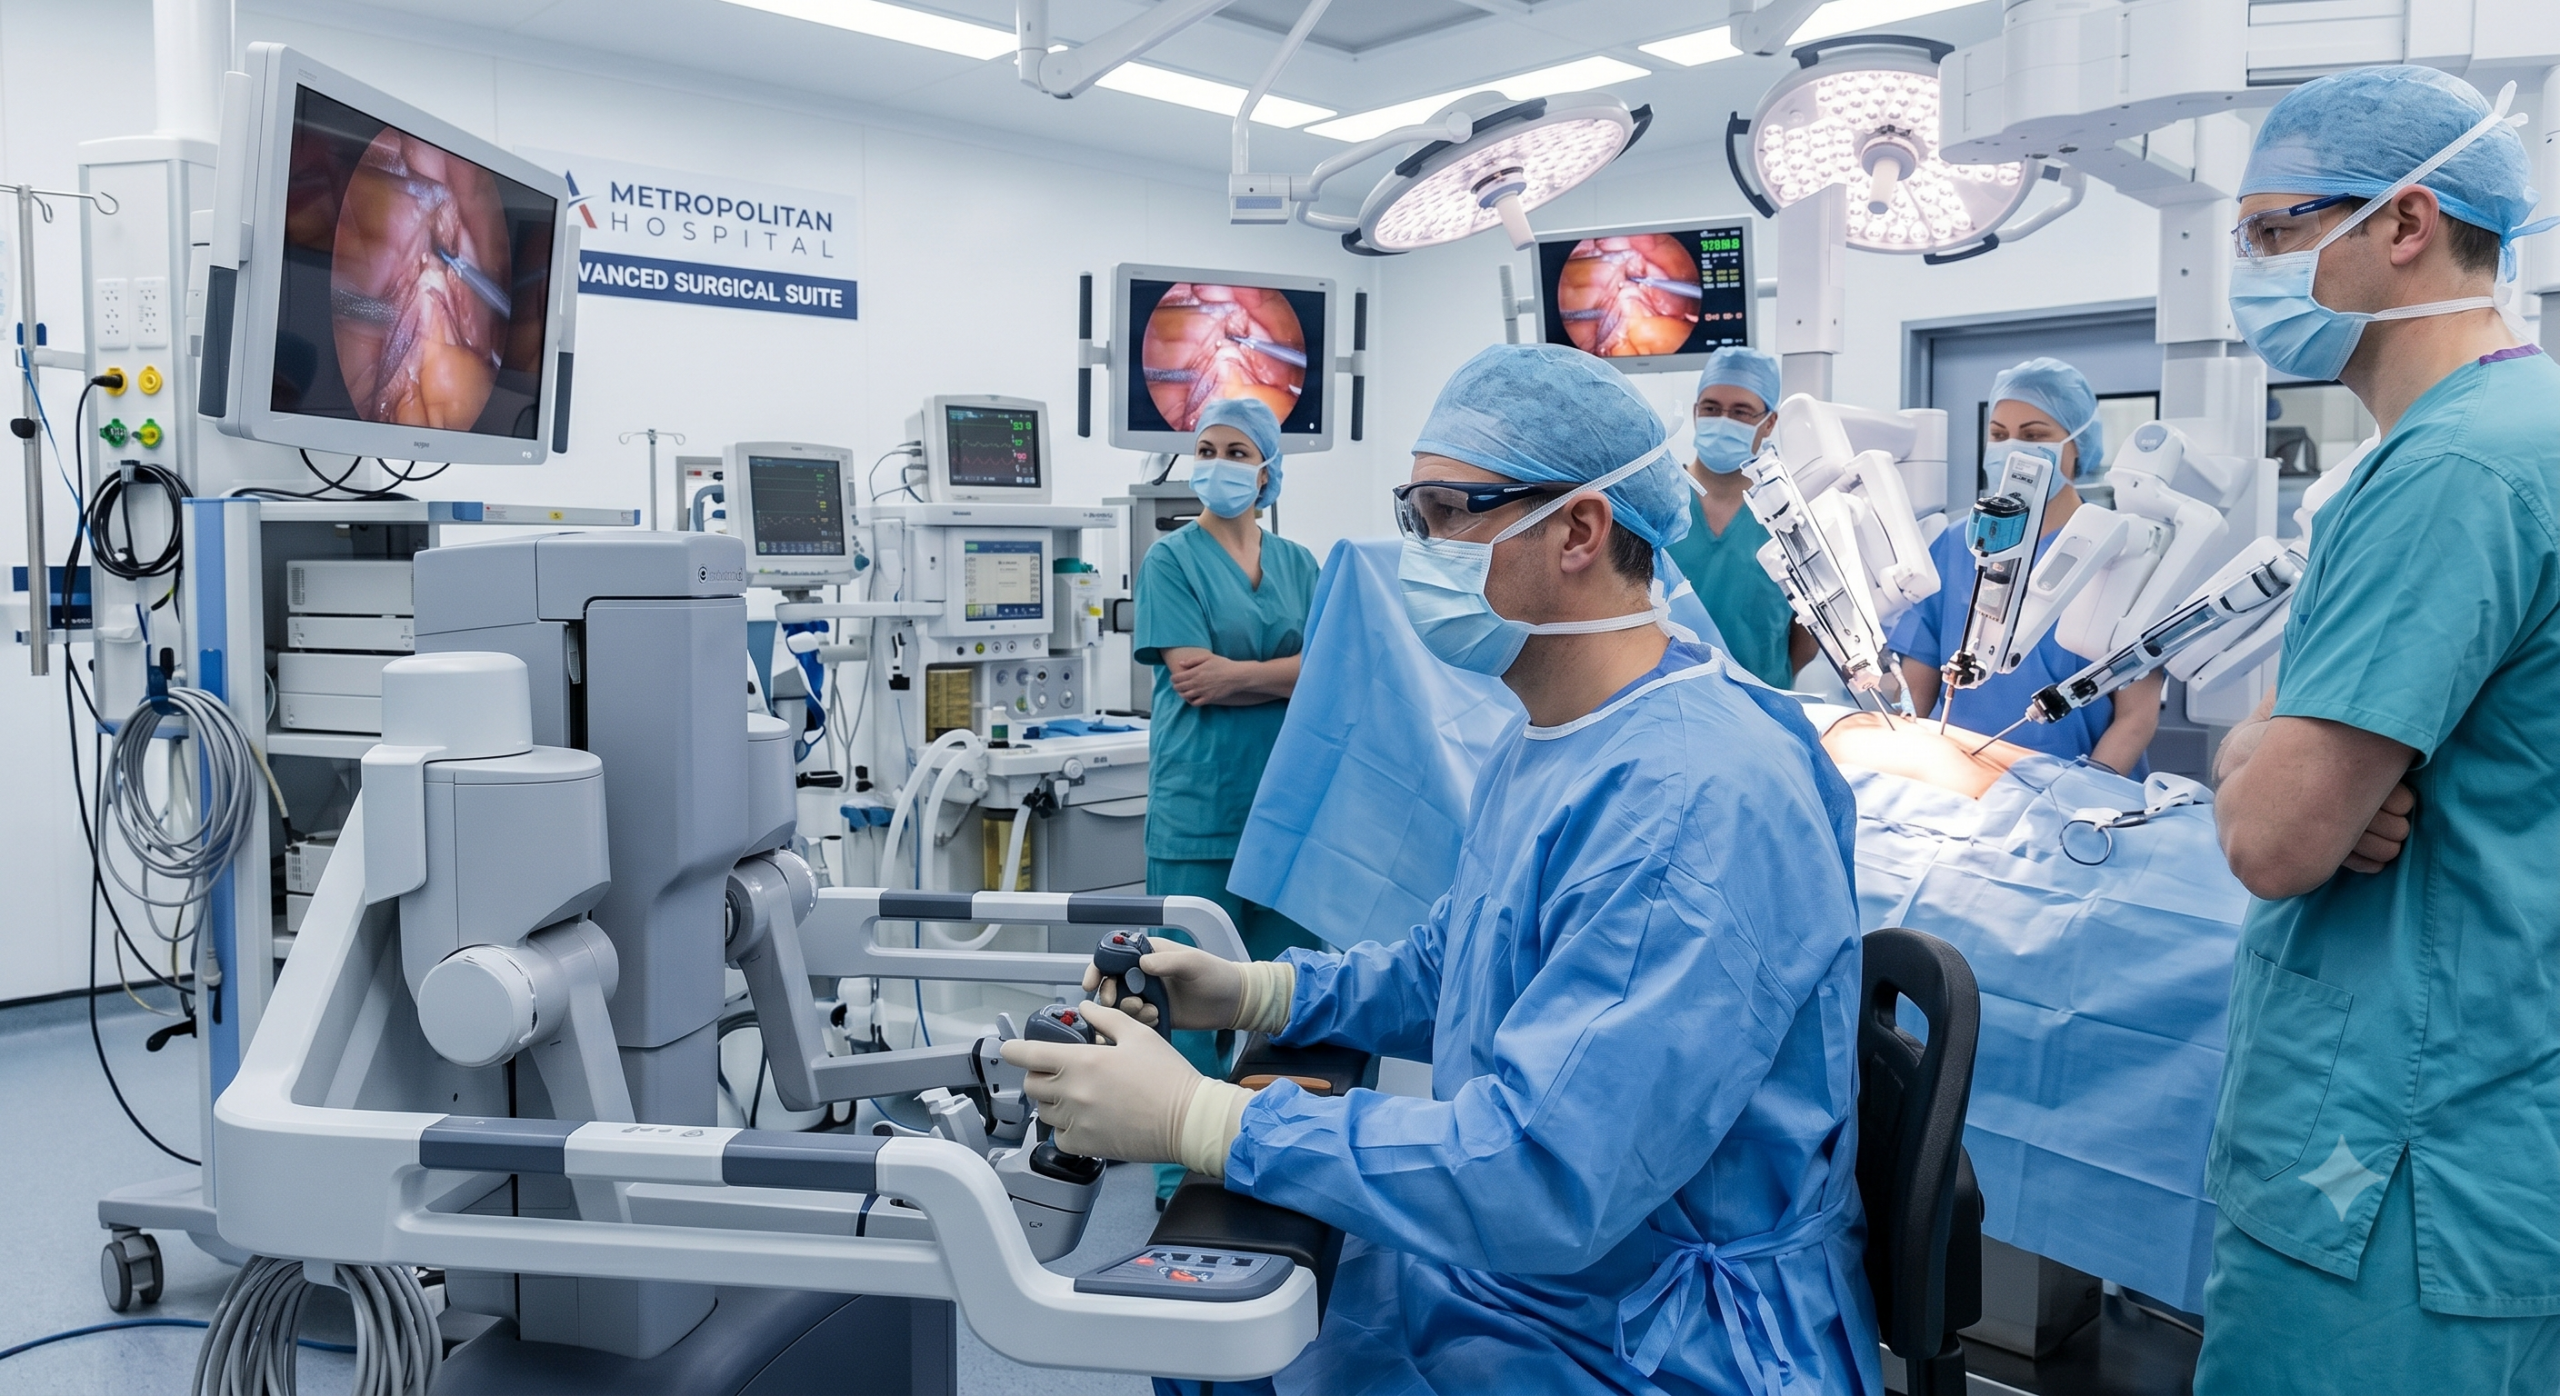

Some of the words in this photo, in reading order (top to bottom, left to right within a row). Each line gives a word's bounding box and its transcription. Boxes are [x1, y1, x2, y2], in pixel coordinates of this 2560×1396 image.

[611, 181, 832, 232] METROPOLITAN
[612, 211, 834, 258] HOSPITAL
[578, 262, 669, 290] VANCED
[673, 271, 781, 302] SURGICAL
[784, 283, 843, 308] SUITE
